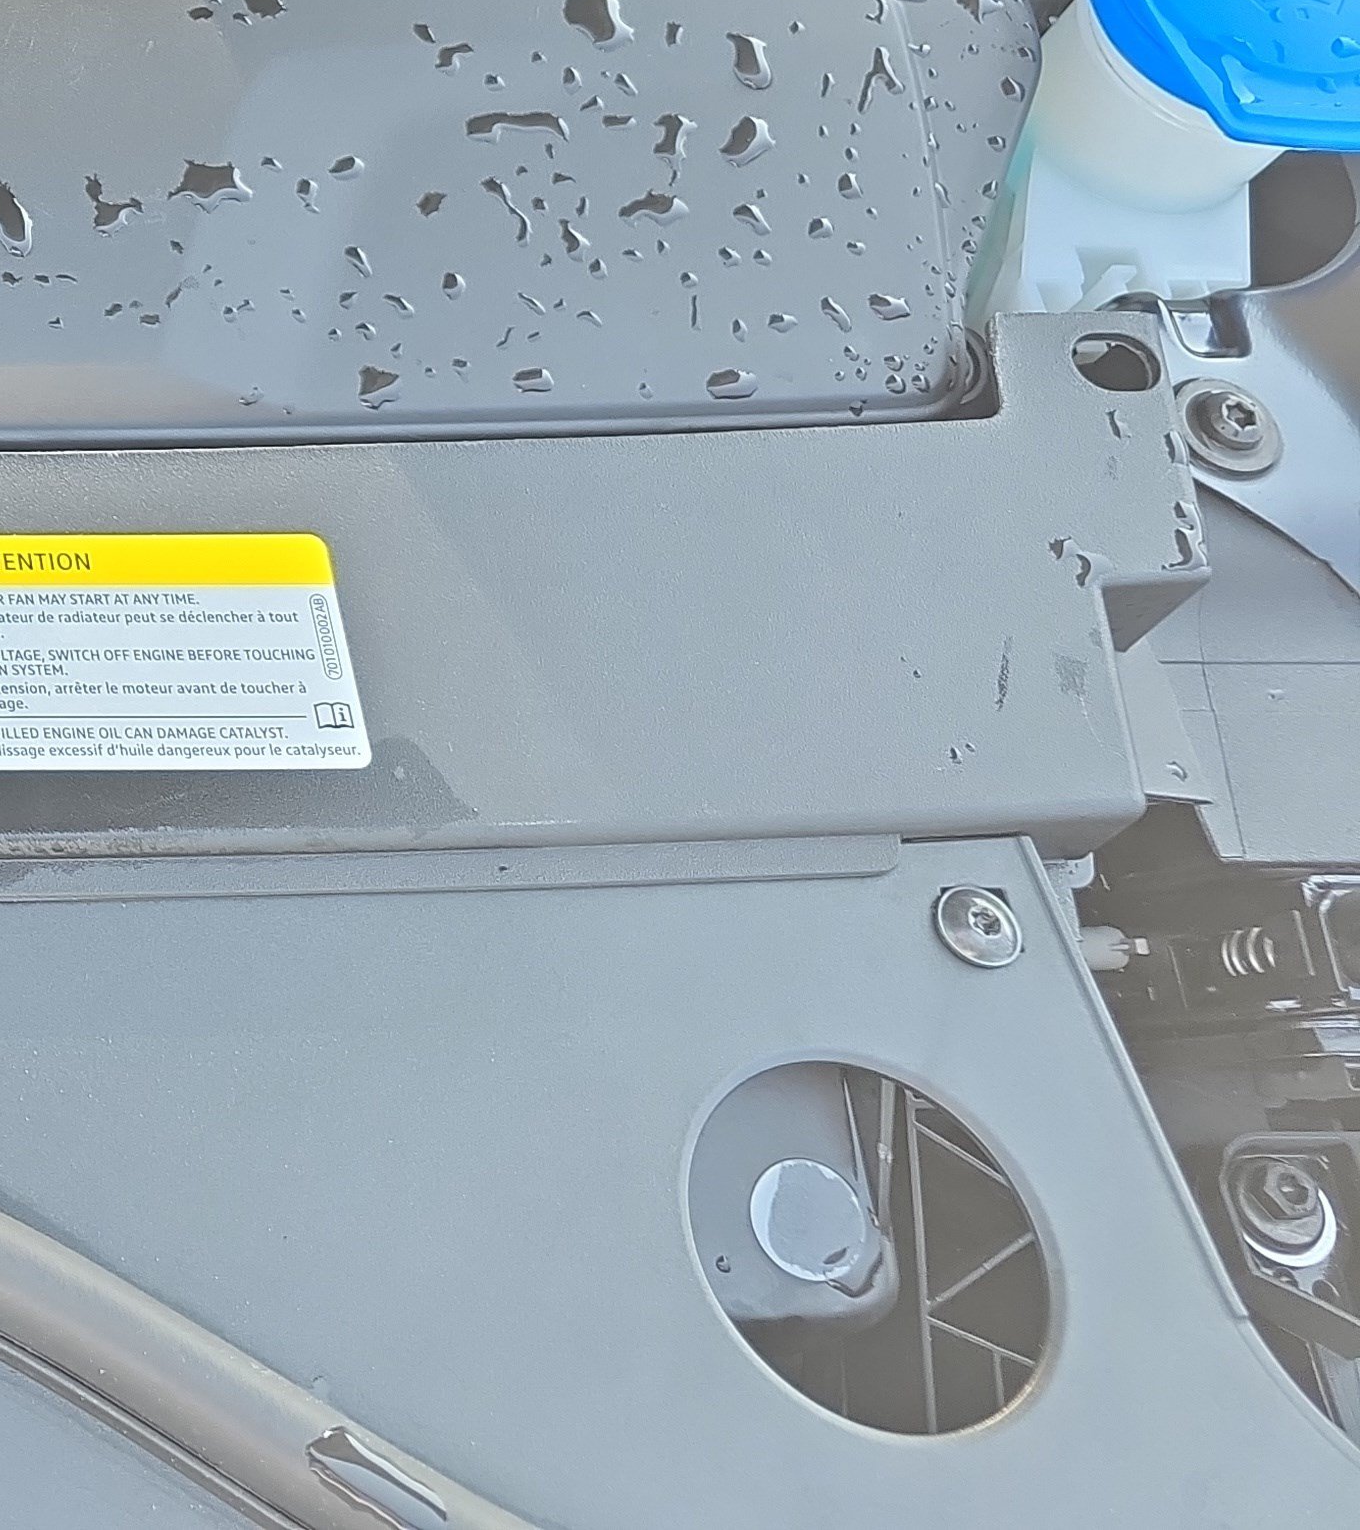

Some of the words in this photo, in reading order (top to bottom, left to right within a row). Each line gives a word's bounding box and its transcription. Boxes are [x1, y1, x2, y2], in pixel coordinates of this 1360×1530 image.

[7, 593, 35, 606] FAN
[37, 593, 67, 606] MAY
[69, 593, 111, 606] START
[113, 593, 130, 605] AT
[133, 593, 160, 605] ANY
[161, 593, 200, 605] TIME.
[37, 610, 55, 623] de
[58, 610, 121, 624] radiateur
[124, 612, 157, 626] peut
[159, 613, 175, 623] se
[178, 610, 254, 623] déclencher
[257, 613, 266, 623] à
[268, 612, 300, 623] tout
[47, 649, 101, 662] SWITCH
[103, 649, 130, 661] OFF
[132, 649, 185, 661] ENGINE
[187, 649, 242, 661] BEFORE
[242, 648, 316, 661] TOUCHING
[11, 663, 69, 676] SYSTEM.
[54, 681, 103, 695] arrêter
[105, 681, 119, 695] le
[122, 683, 173, 695] moteur
[176, 683, 217, 695] avant
[219, 681, 237, 695] de
[240, 681, 295, 695] toucher
[298, 681, 307, 694] à
[42, 727, 96, 740] ENGINE
[98, 727, 123, 740] OIL
[124, 726, 154, 739] CAN
[156, 726, 217, 739] DAMAGE
[219, 726, 289, 739] CATALYST.
[48, 743, 103, 757] excessif
[106, 743, 154, 757] d'huile
[157, 743, 231, 760] dangereux
[233, 746, 266, 759] pour
[268, 743, 282, 756] le
[285, 742, 361, 759] catalyseur.
